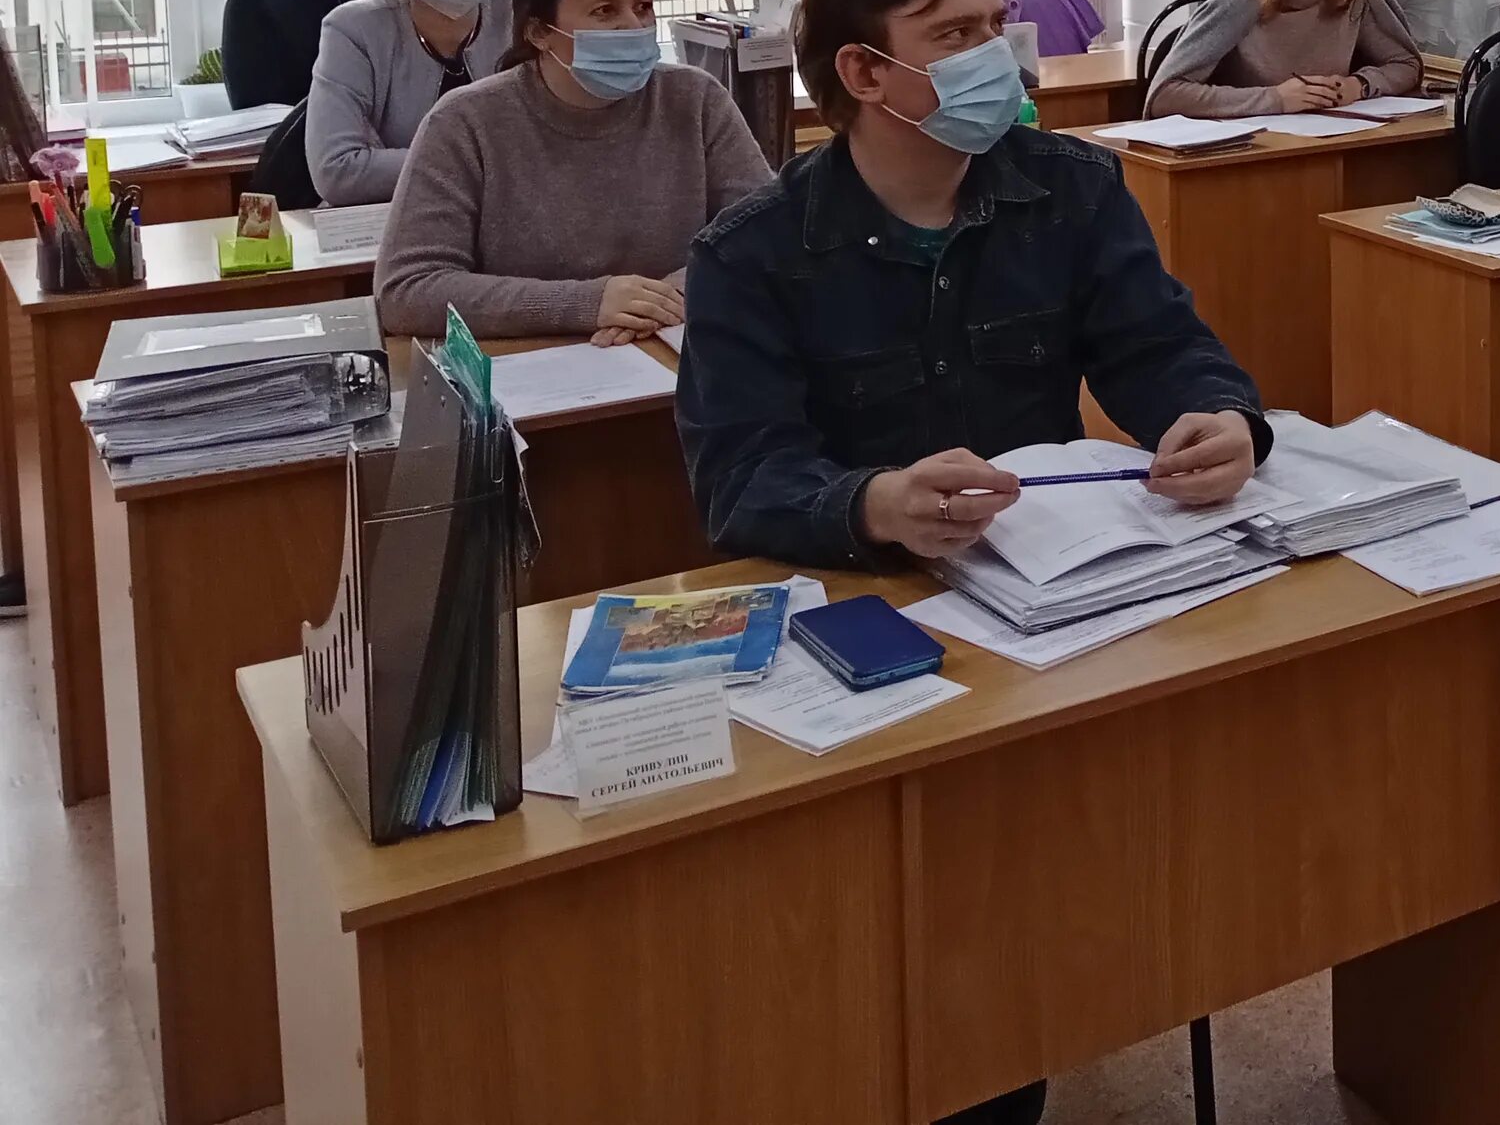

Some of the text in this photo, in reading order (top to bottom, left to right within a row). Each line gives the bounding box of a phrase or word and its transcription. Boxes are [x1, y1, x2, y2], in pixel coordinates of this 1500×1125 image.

[591, 758, 724, 797] СЕРГЕЙ АНАТОЛЬЕВИЧ
[626, 754, 689, 776] КРИВУЛИН
